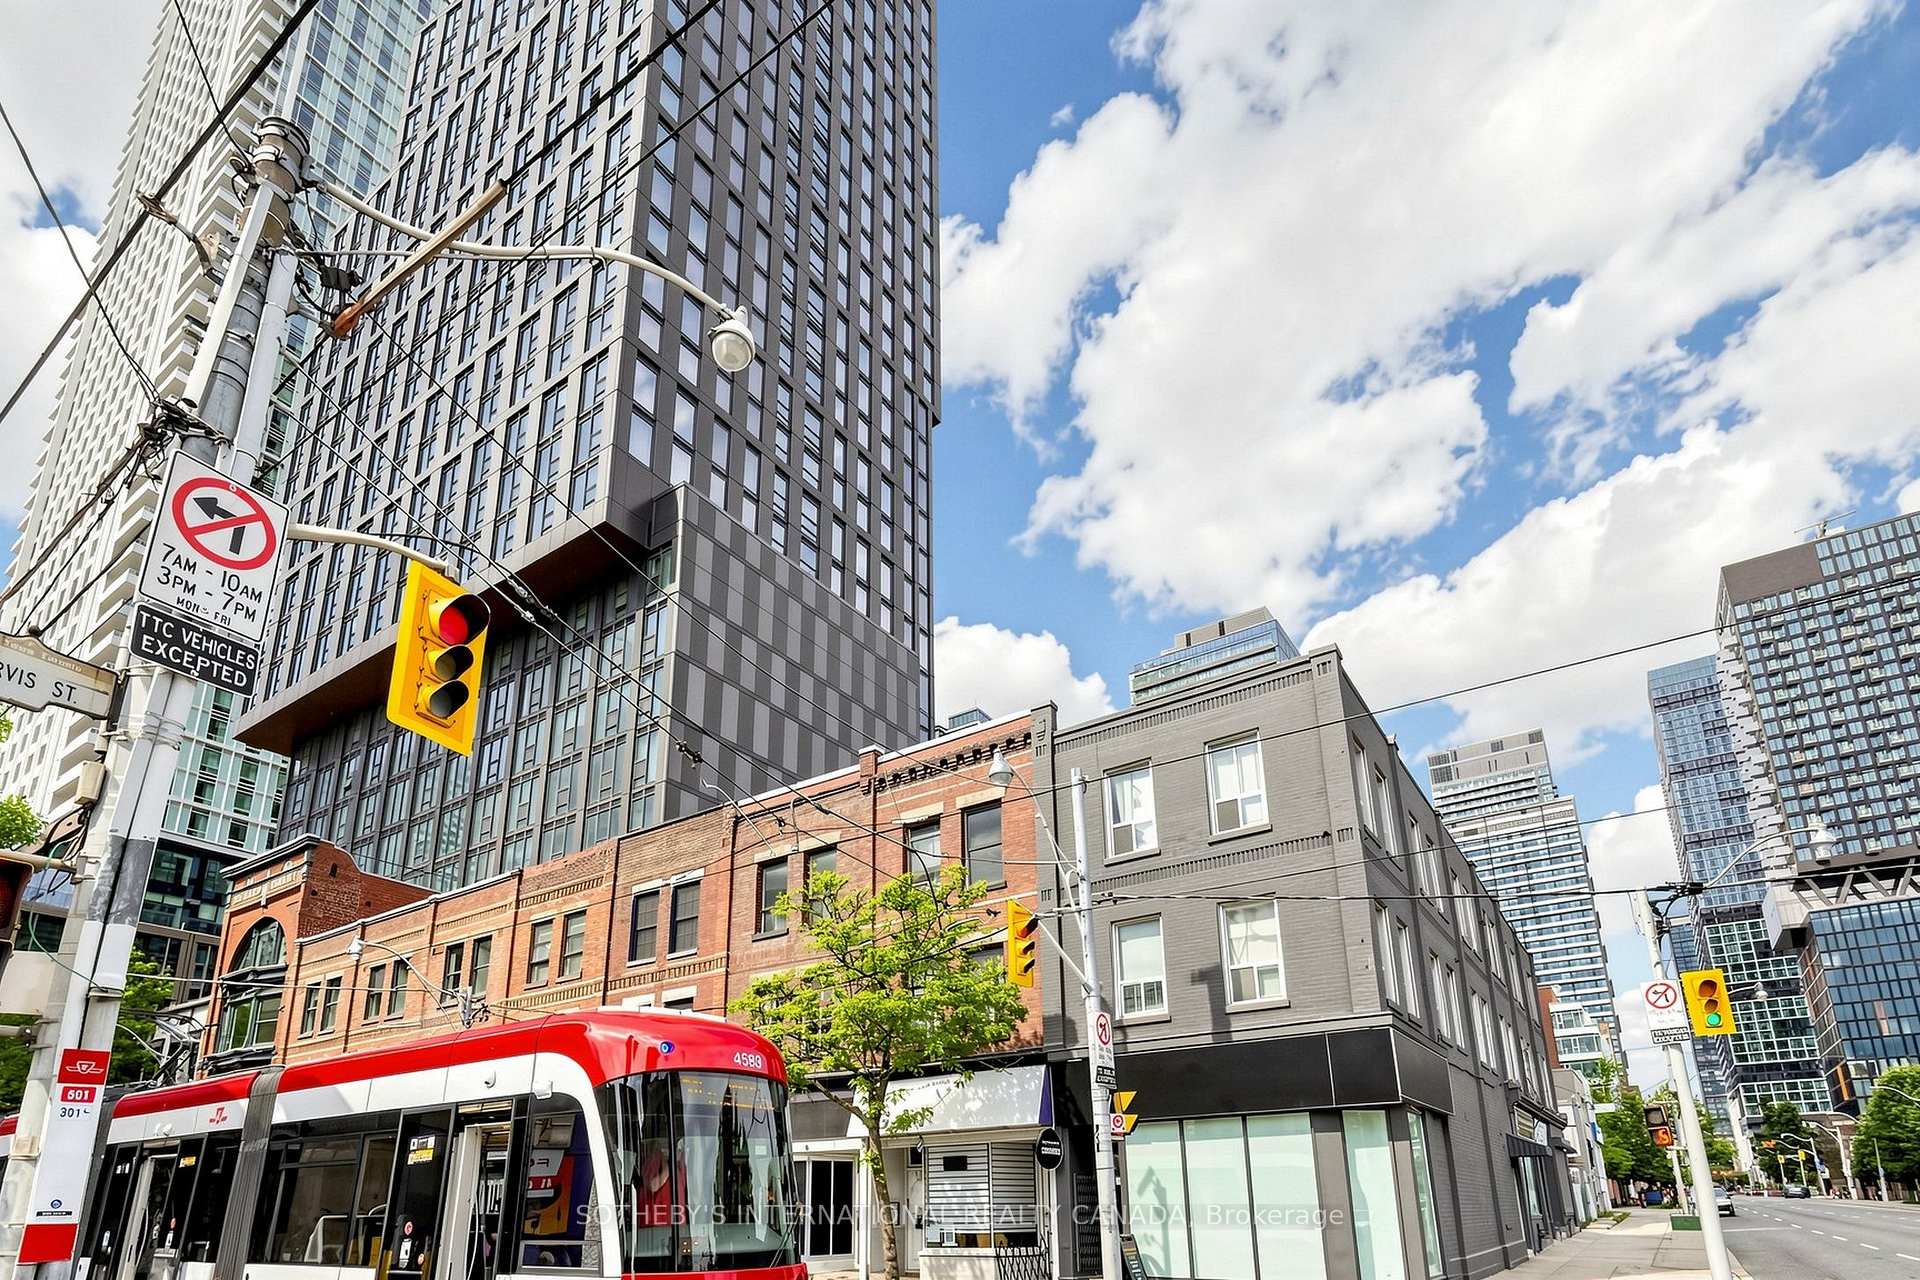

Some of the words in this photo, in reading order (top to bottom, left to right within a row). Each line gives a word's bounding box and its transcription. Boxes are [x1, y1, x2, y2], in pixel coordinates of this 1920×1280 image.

[156, 565, 197, 596] 3PM
[222, 591, 257, 623] 7PM
[162, 542, 197, 575] 7AM
[221, 570, 263, 604] 10AM
[176, 596, 200, 613] MON
[213, 611, 231, 626] FRI
[139, 610, 175, 638] TTC
[181, 627, 256, 670] VEHICLES
[141, 634, 248, 688] EXCEPTED
[51, 681, 77, 704] ST.
[59, 1107, 81, 1118] 301
[67, 1089, 90, 1101] 601
